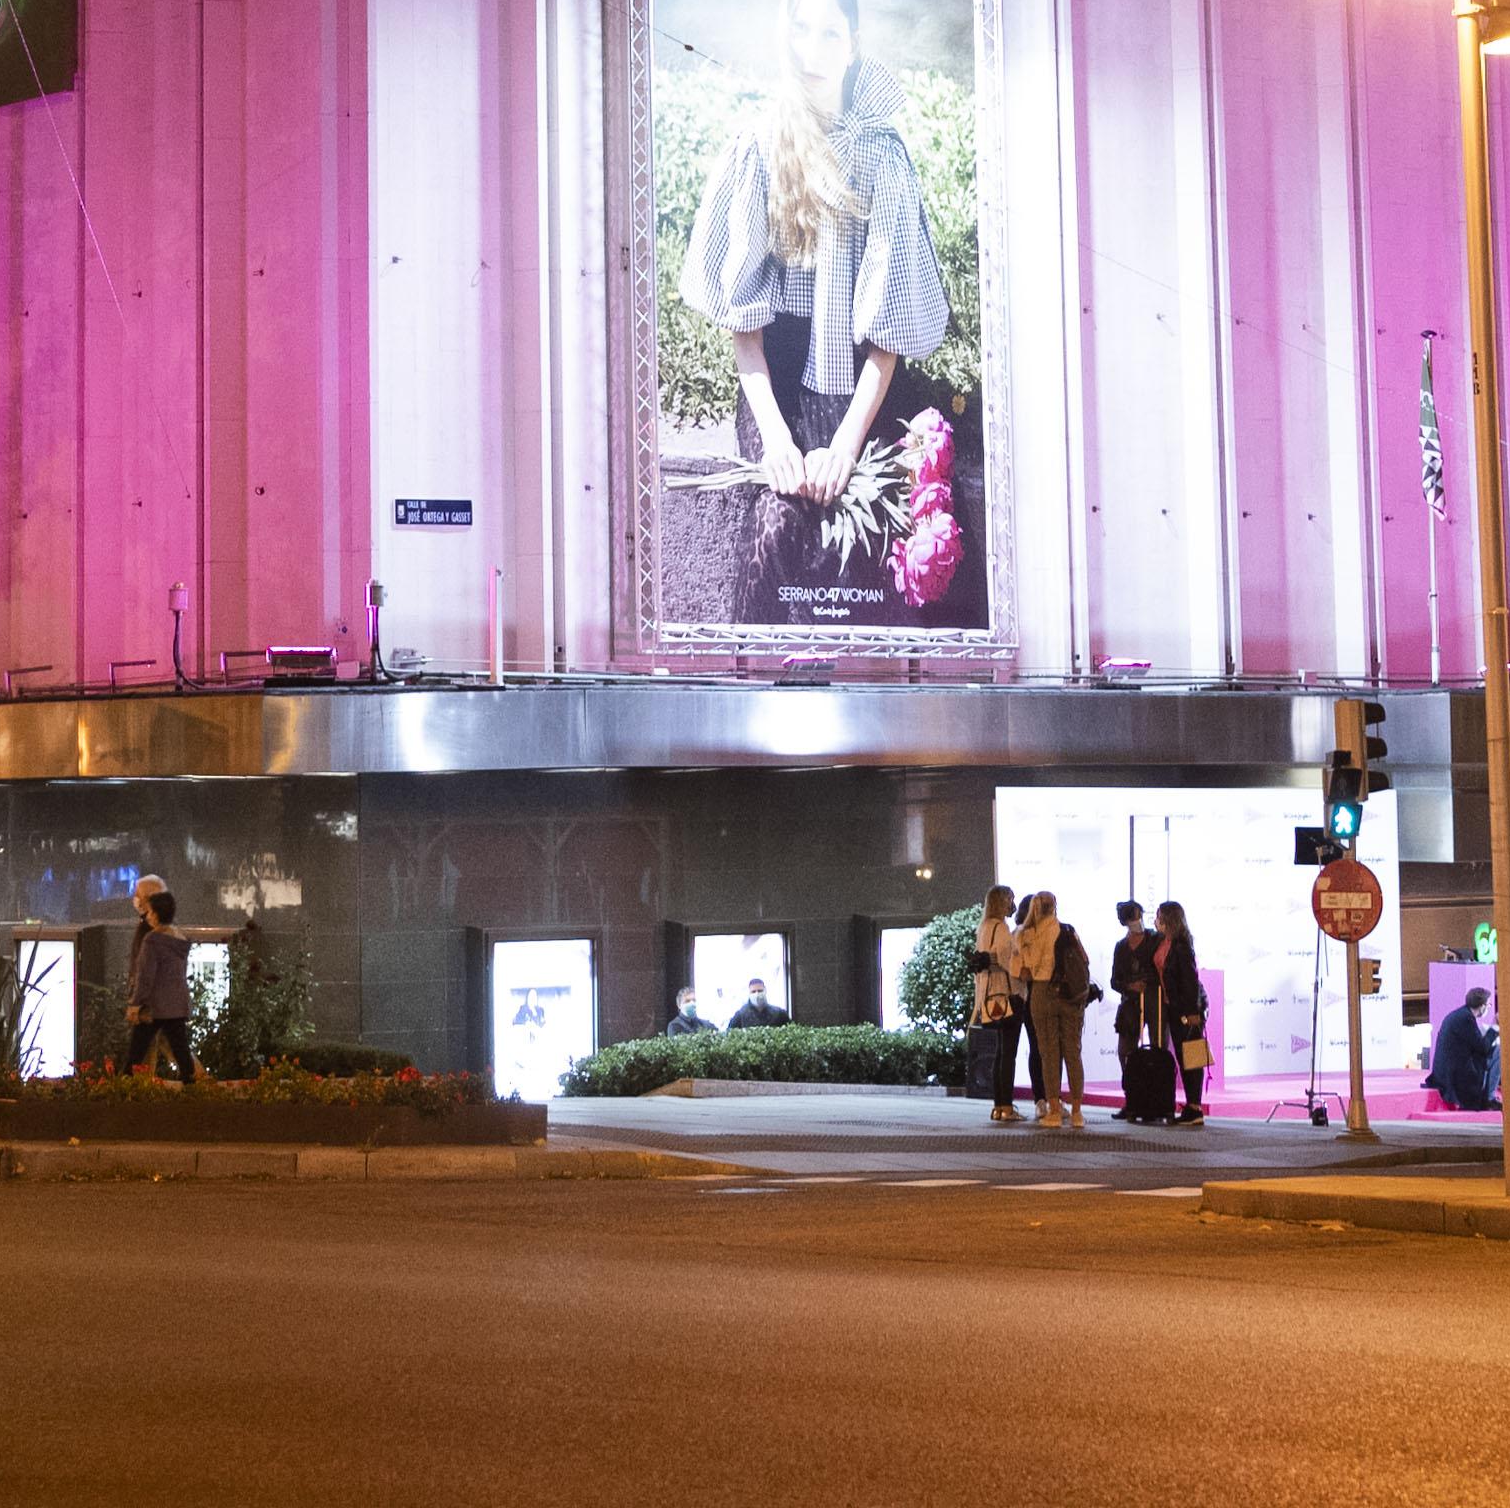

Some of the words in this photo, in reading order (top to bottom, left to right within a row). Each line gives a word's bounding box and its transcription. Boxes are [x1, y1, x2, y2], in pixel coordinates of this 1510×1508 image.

[407, 509, 421, 524] JOSÉ
[422, 511, 444, 523] ORTEGA
[451, 512, 471, 523] GASSET
